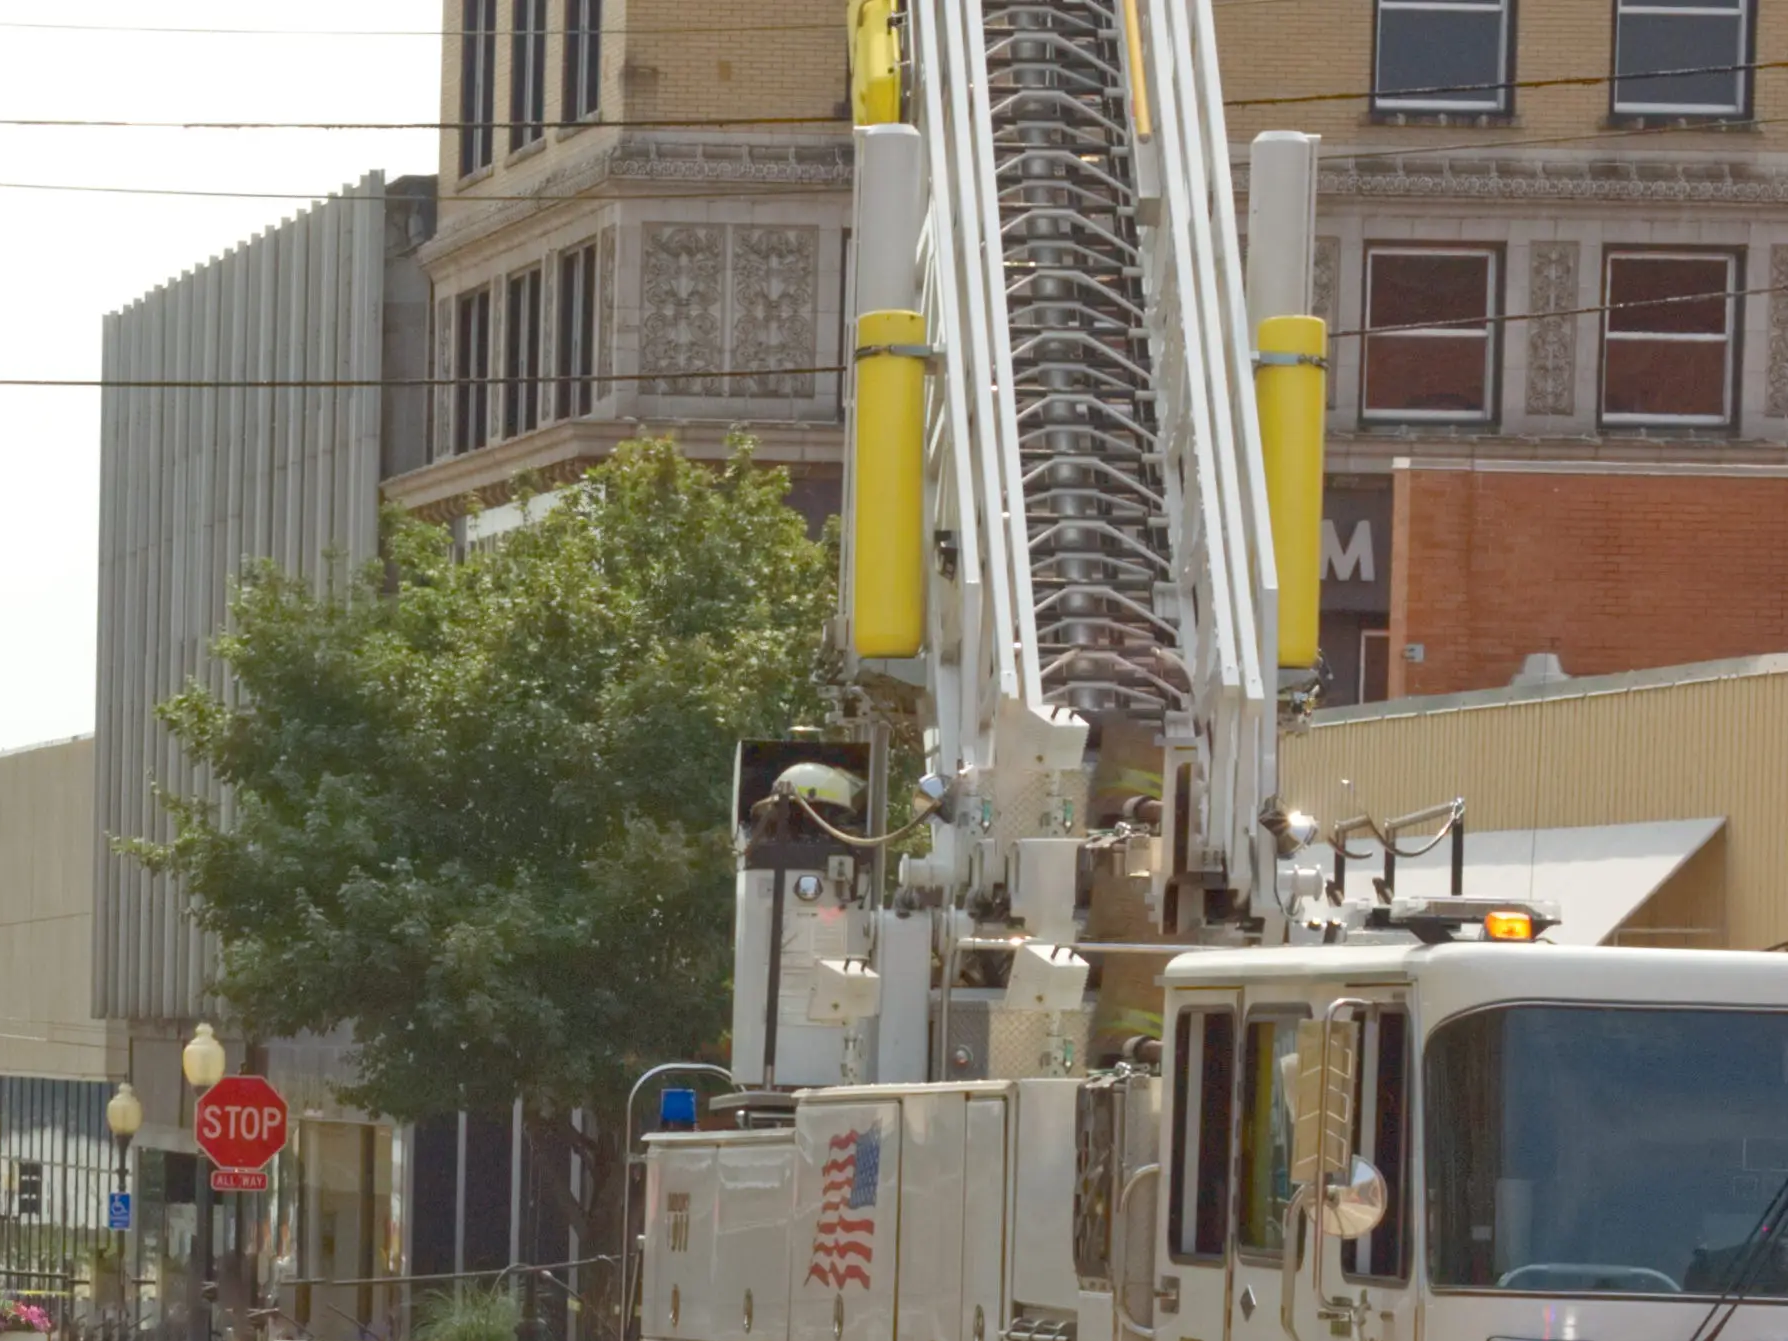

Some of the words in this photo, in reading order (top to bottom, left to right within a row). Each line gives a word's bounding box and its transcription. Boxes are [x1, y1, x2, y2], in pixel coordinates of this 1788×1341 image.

[203, 1105, 282, 1140] STOP
[217, 1176, 234, 1185] ALL
[242, 1177, 263, 1186] WAY
